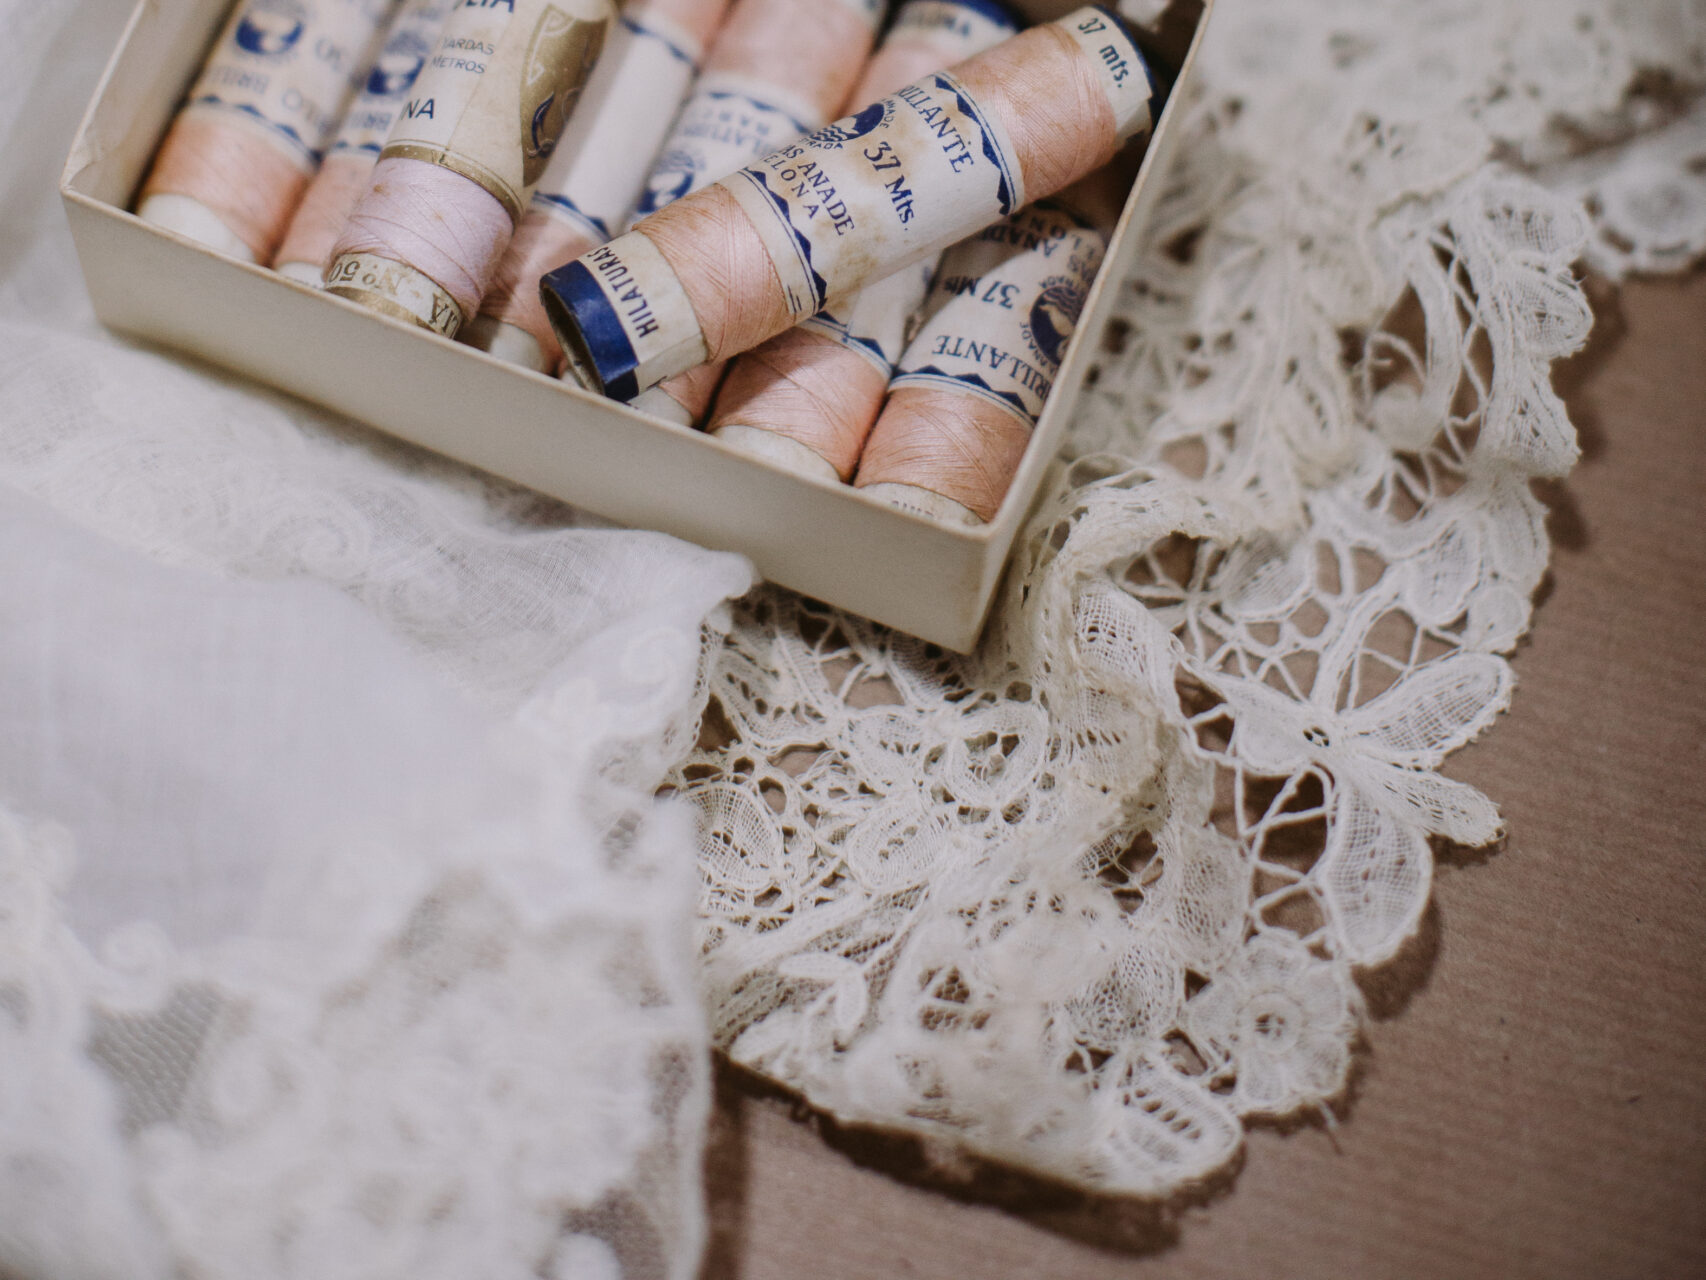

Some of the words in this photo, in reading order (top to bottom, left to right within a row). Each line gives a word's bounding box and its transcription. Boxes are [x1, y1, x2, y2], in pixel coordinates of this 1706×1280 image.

[432, 55, 488, 74] METROS
[1078, 18, 1106, 34] 37
[1099, 44, 1129, 88] mts.
[797, 161, 855, 236] ANADE
[863, 140, 901, 172] 37
[885, 175, 916, 231] Mts.
[328, 260, 361, 283] 50
[587, 246, 659, 338] HILATURAS
[981, 280, 1021, 309] 37
